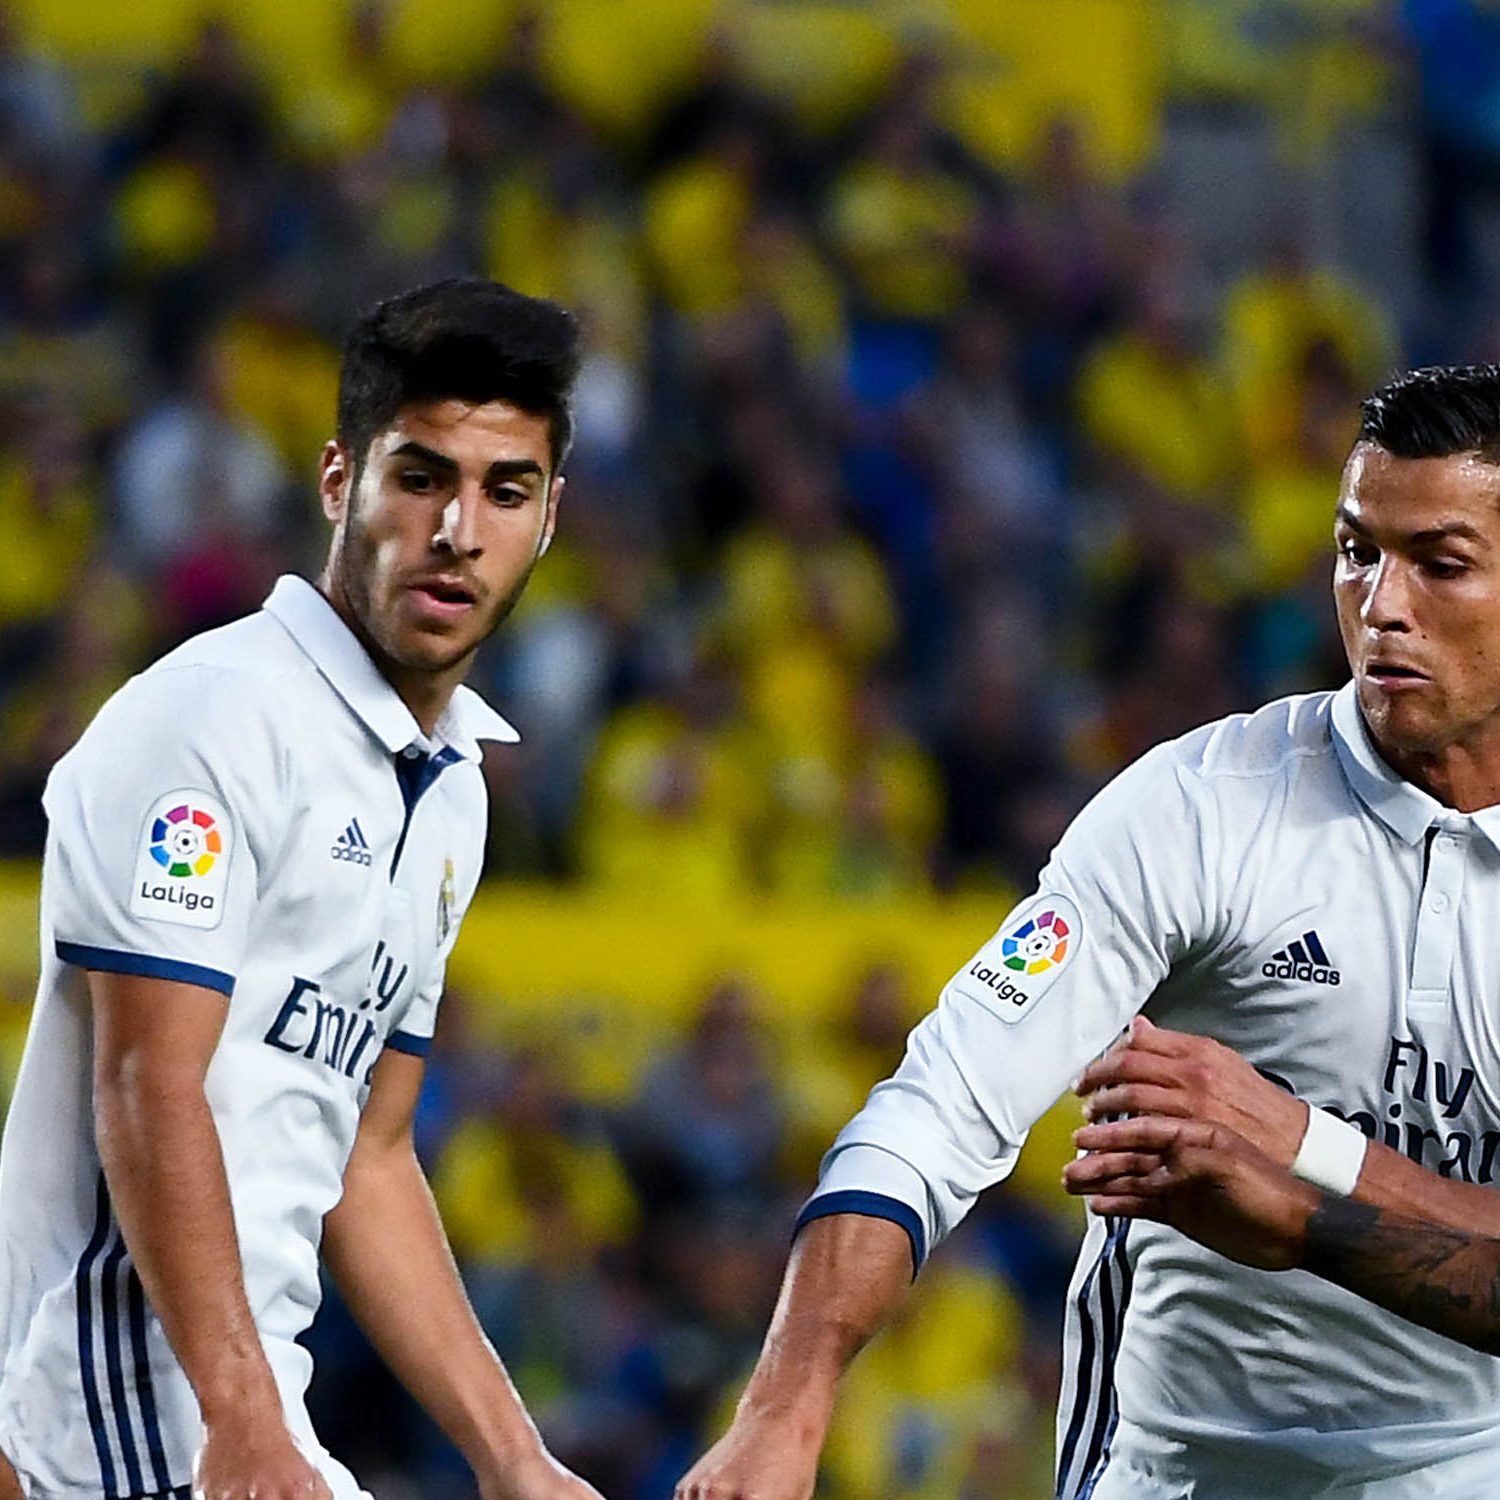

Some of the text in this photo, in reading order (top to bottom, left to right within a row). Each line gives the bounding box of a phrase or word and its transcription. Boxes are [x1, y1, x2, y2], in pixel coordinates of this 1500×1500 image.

[141, 881, 215, 910] LaLiga
[969, 960, 1029, 1007] LaLiga
[1262, 960, 1341, 986] adidas
[263, 975, 377, 1086] Emir
[1384, 1036, 1475, 1119] Fly
